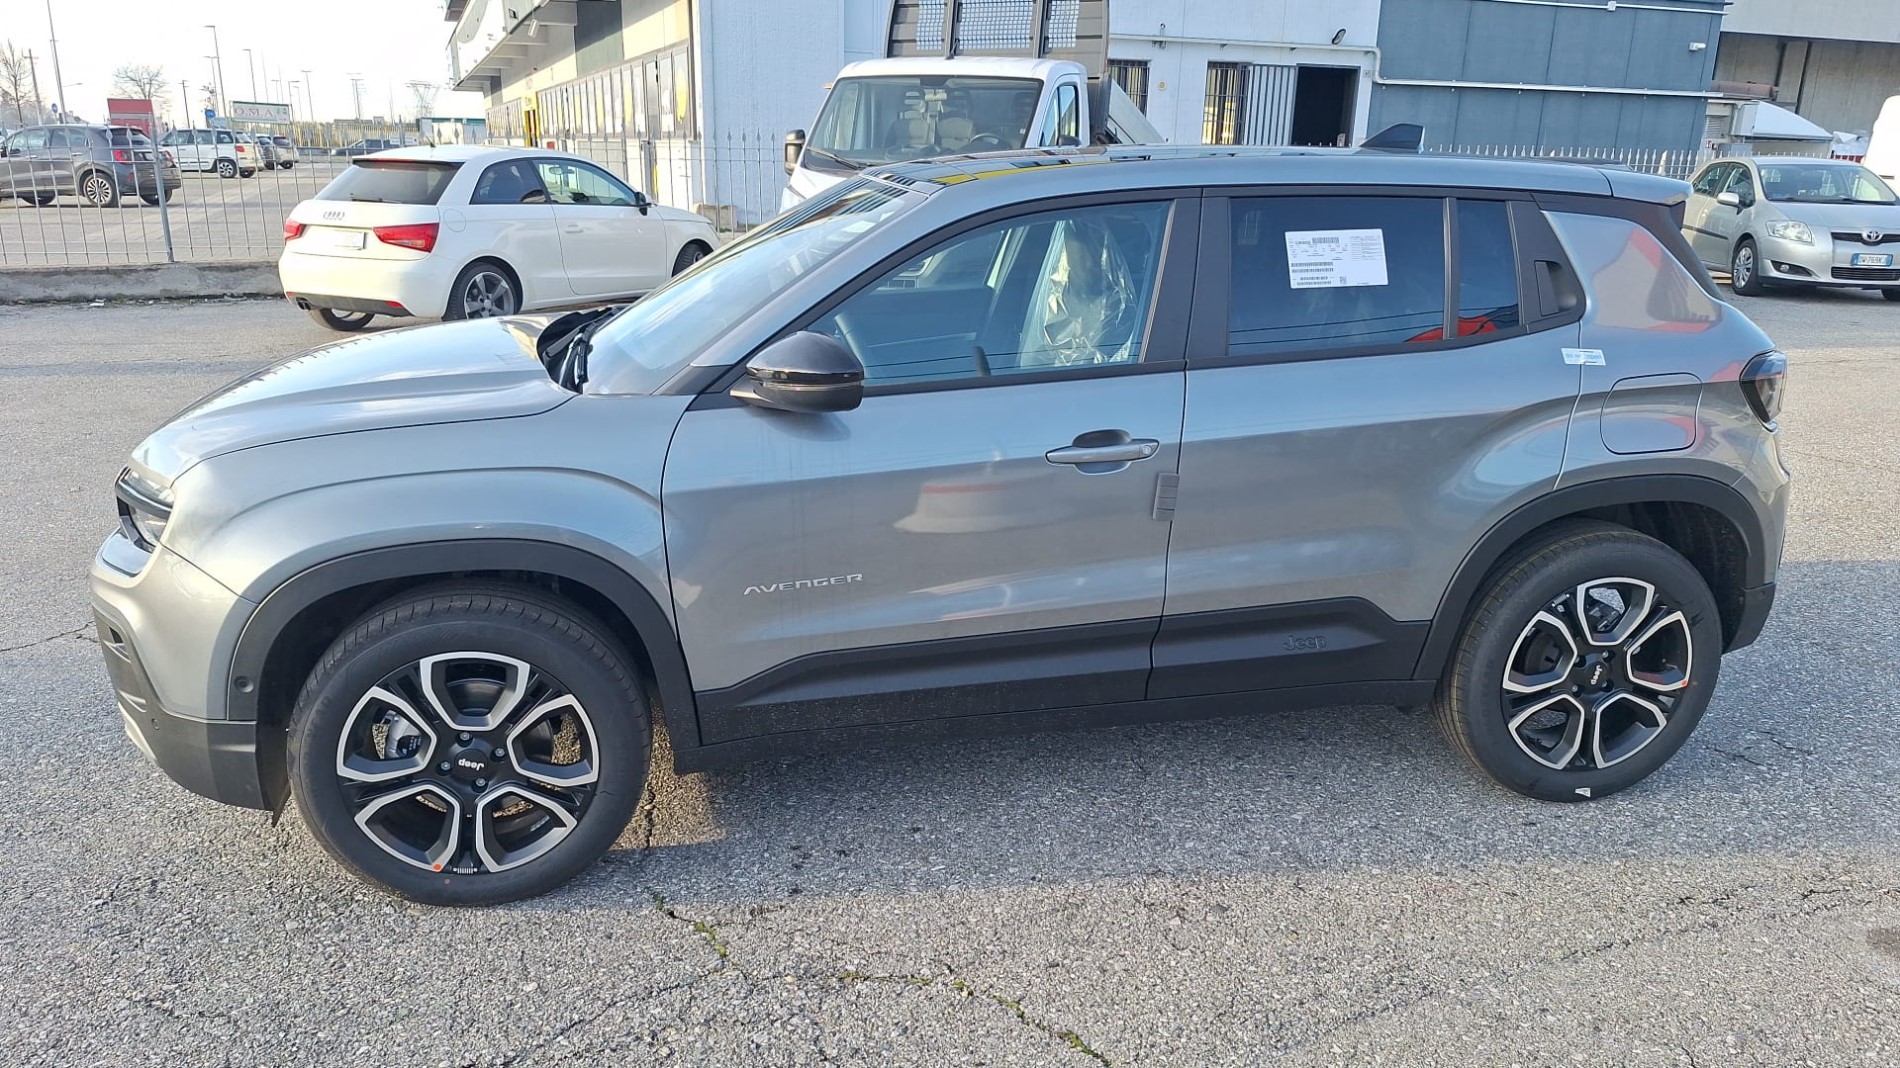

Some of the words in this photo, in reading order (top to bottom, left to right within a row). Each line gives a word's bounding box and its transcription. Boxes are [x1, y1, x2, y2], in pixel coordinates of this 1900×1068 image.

[743, 573, 864, 596] AVENGER
[1283, 634, 1327, 651] Jeep
[458, 758, 485, 771] Jeep
